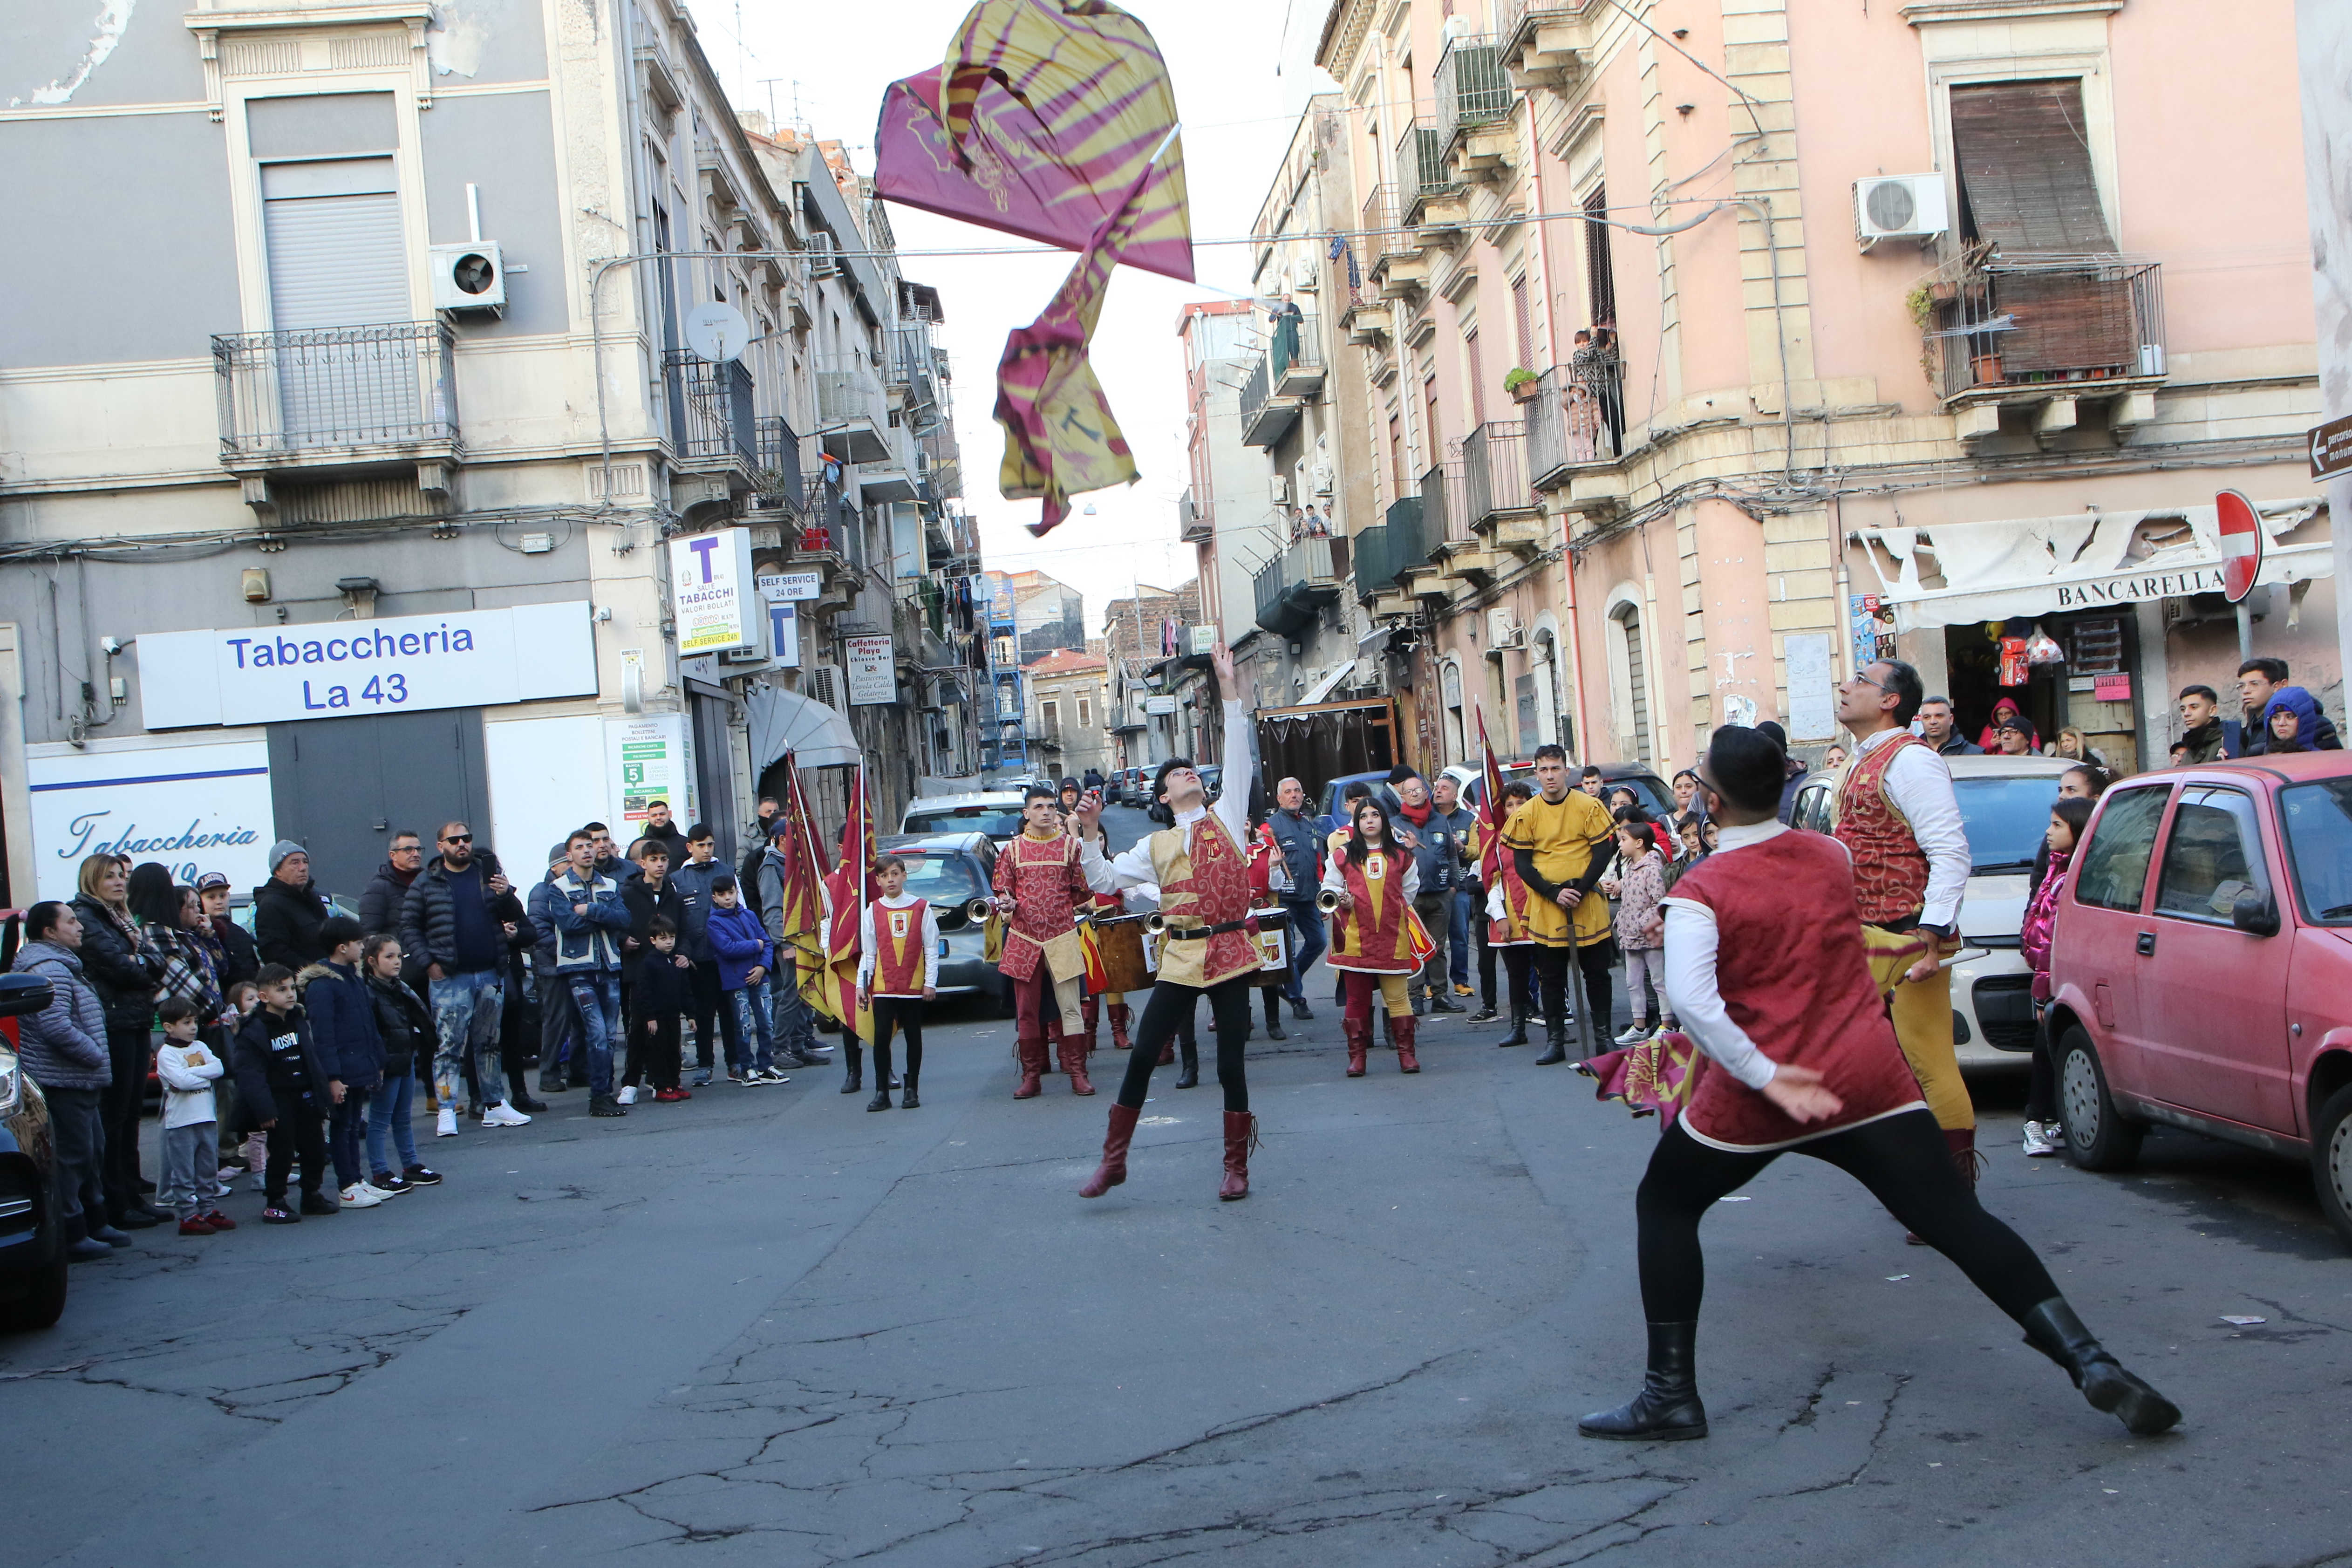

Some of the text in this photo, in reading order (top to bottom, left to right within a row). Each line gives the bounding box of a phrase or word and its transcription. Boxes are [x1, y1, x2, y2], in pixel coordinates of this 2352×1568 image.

[2328, 429, 2352, 448] percorso
[690, 537, 719, 584] T
[761, 575, 816, 586] SELF SERVICE
[2058, 569, 2225, 606] BANCARELLA
[680, 587, 734, 605] TABACCHI
[787, 587, 803, 596] ORE
[682, 600, 734, 614] VALORI BOLLATI
[770, 607, 794, 656] T
[227, 623, 474, 669] Tabaccheria
[683, 639, 698, 648] SELF
[700, 635, 725, 645] SERVICE
[848, 638, 890, 648] Caffetteria
[304, 674, 408, 710] La 43
[629, 768, 638, 781] 5
[58, 810, 259, 858] Tabaccheria
